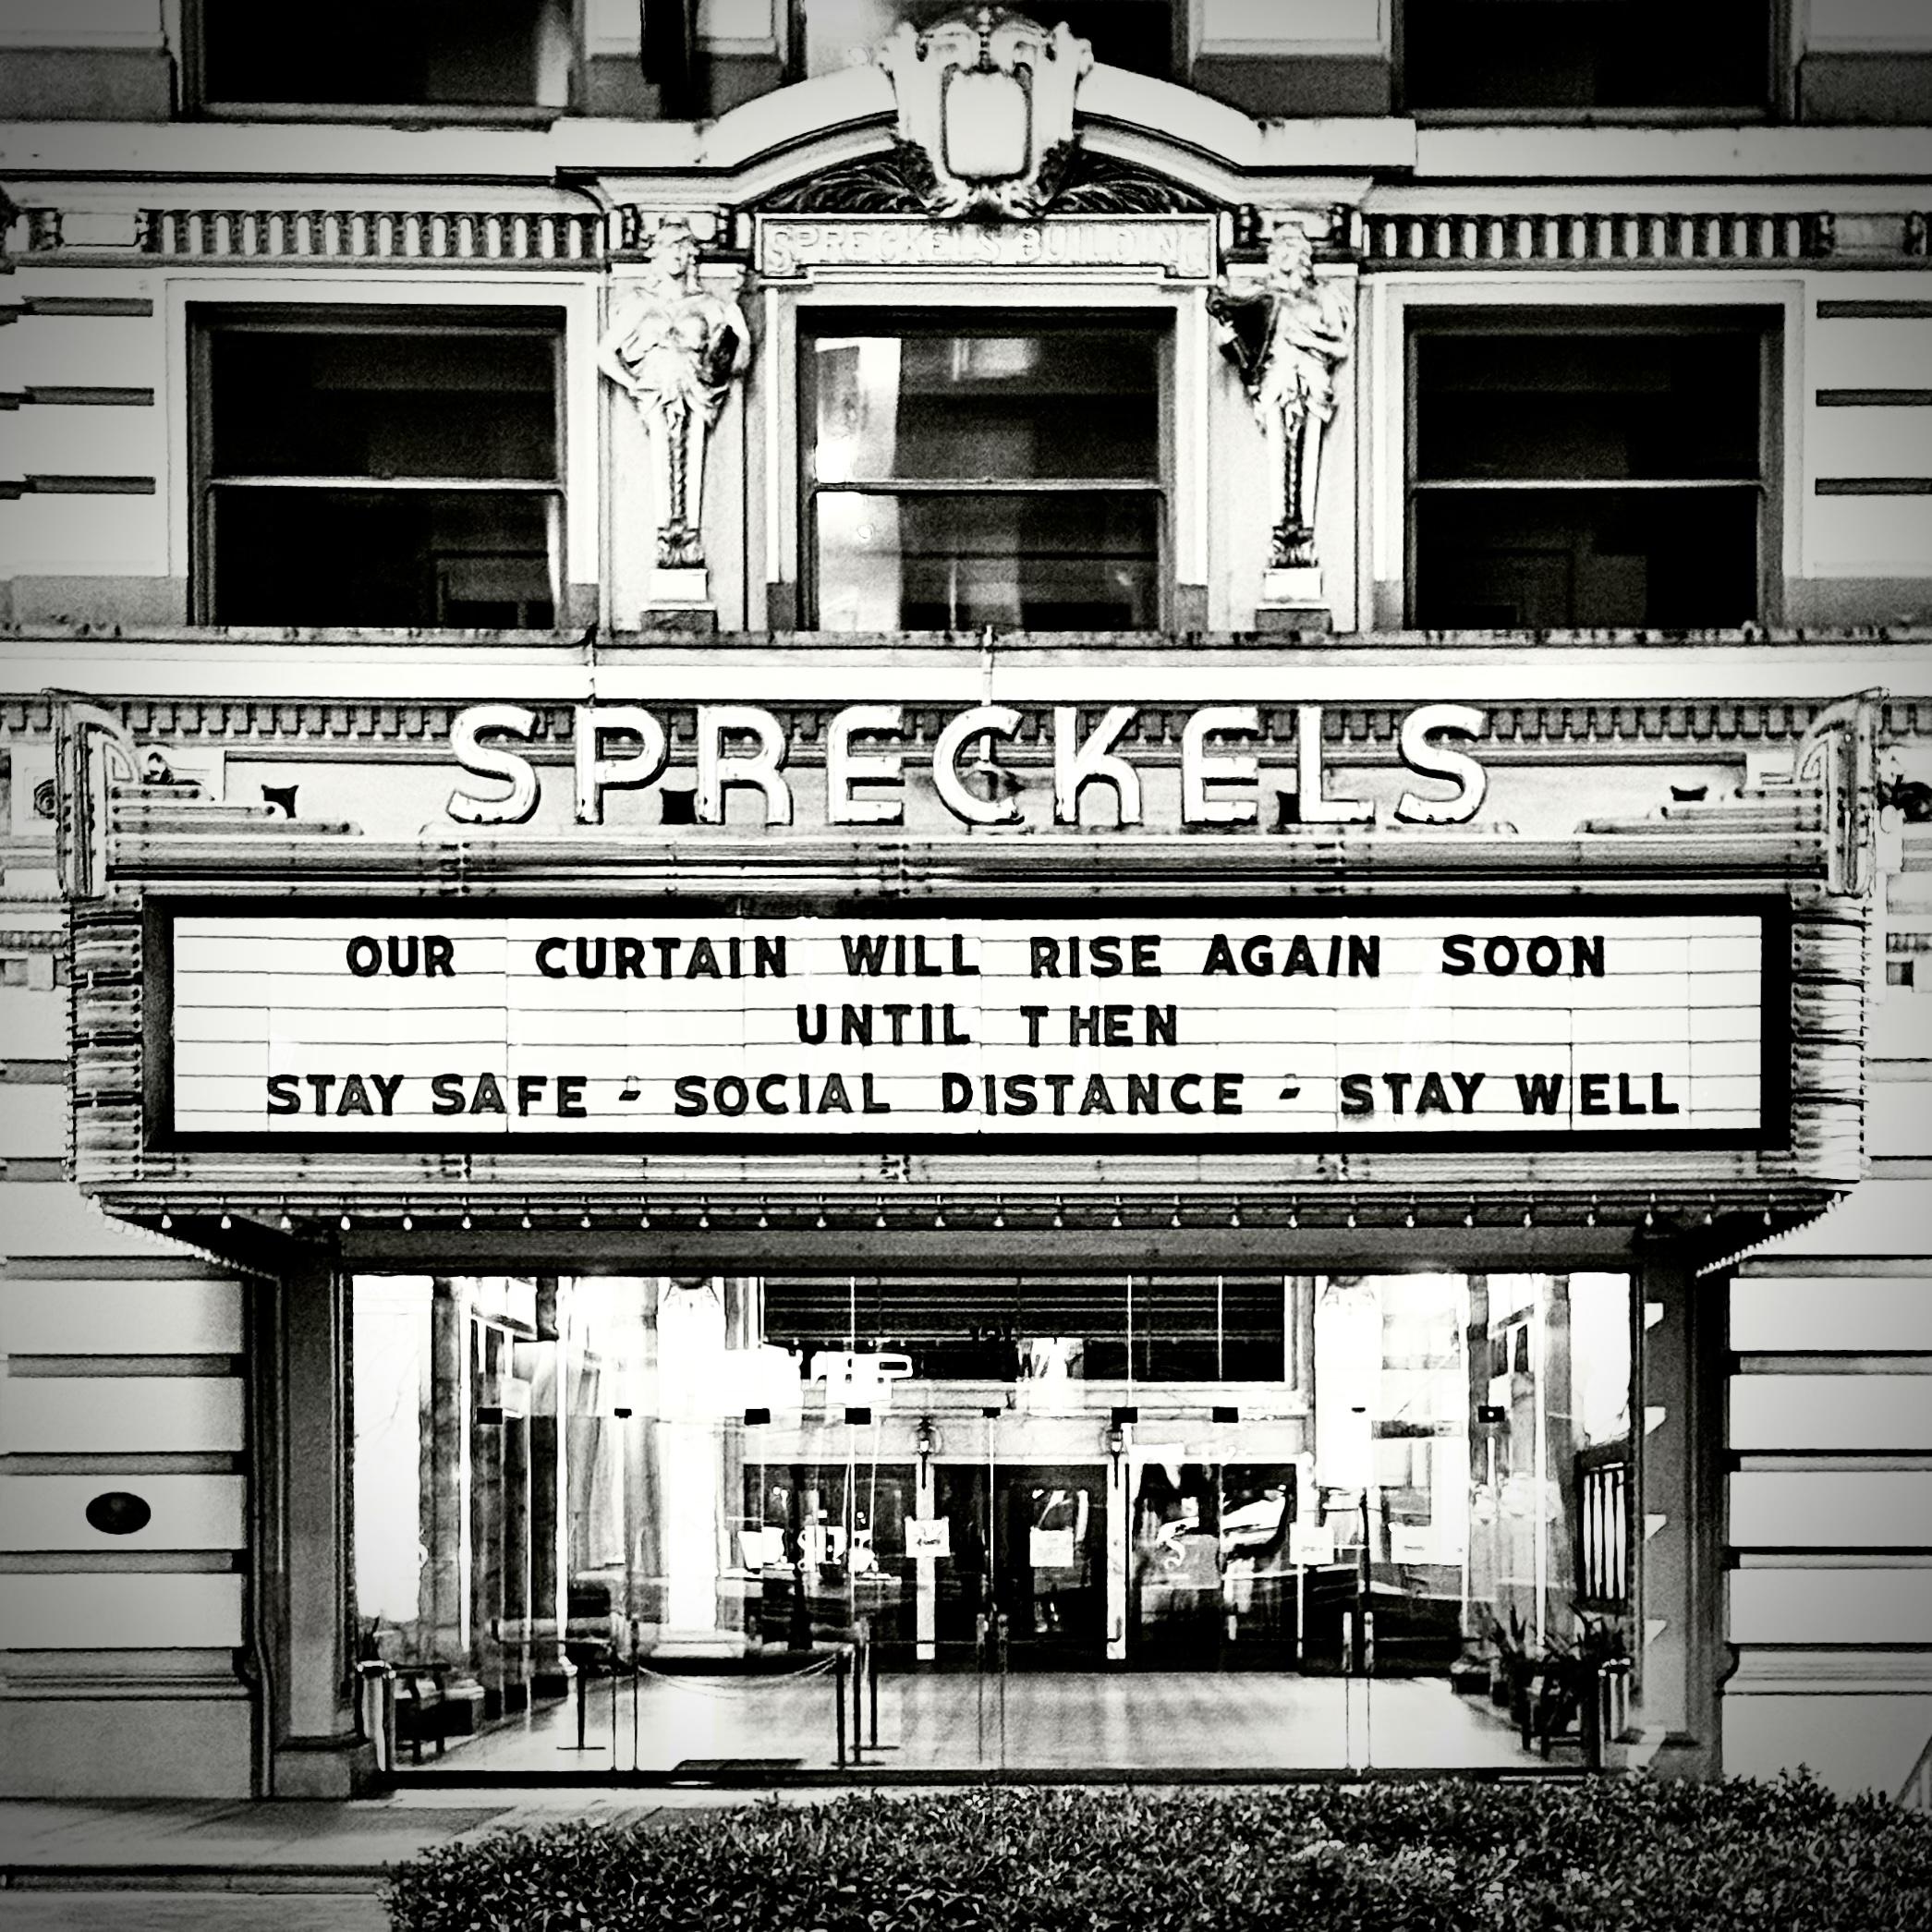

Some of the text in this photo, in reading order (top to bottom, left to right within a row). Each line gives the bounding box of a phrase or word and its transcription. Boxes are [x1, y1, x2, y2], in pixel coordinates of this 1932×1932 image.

[765, 225, 1209, 276] SPRECKELS BUILDING
[446, 703, 1488, 825] SPRECKELS
[346, 933, 1606, 980] OUR CURTAIN WILL RISE AGAIN SOON
[796, 1002, 1179, 1049] UNTIL THEN
[266, 1074, 406, 1117] STAY
[431, 1072, 589, 1118] SAFE
[674, 1072, 893, 1117] SOCIAL
[941, 1072, 1245, 1116] DISTANCE
[1340, 1072, 1487, 1116] STAY
[1514, 1072, 1681, 1116] WELL
